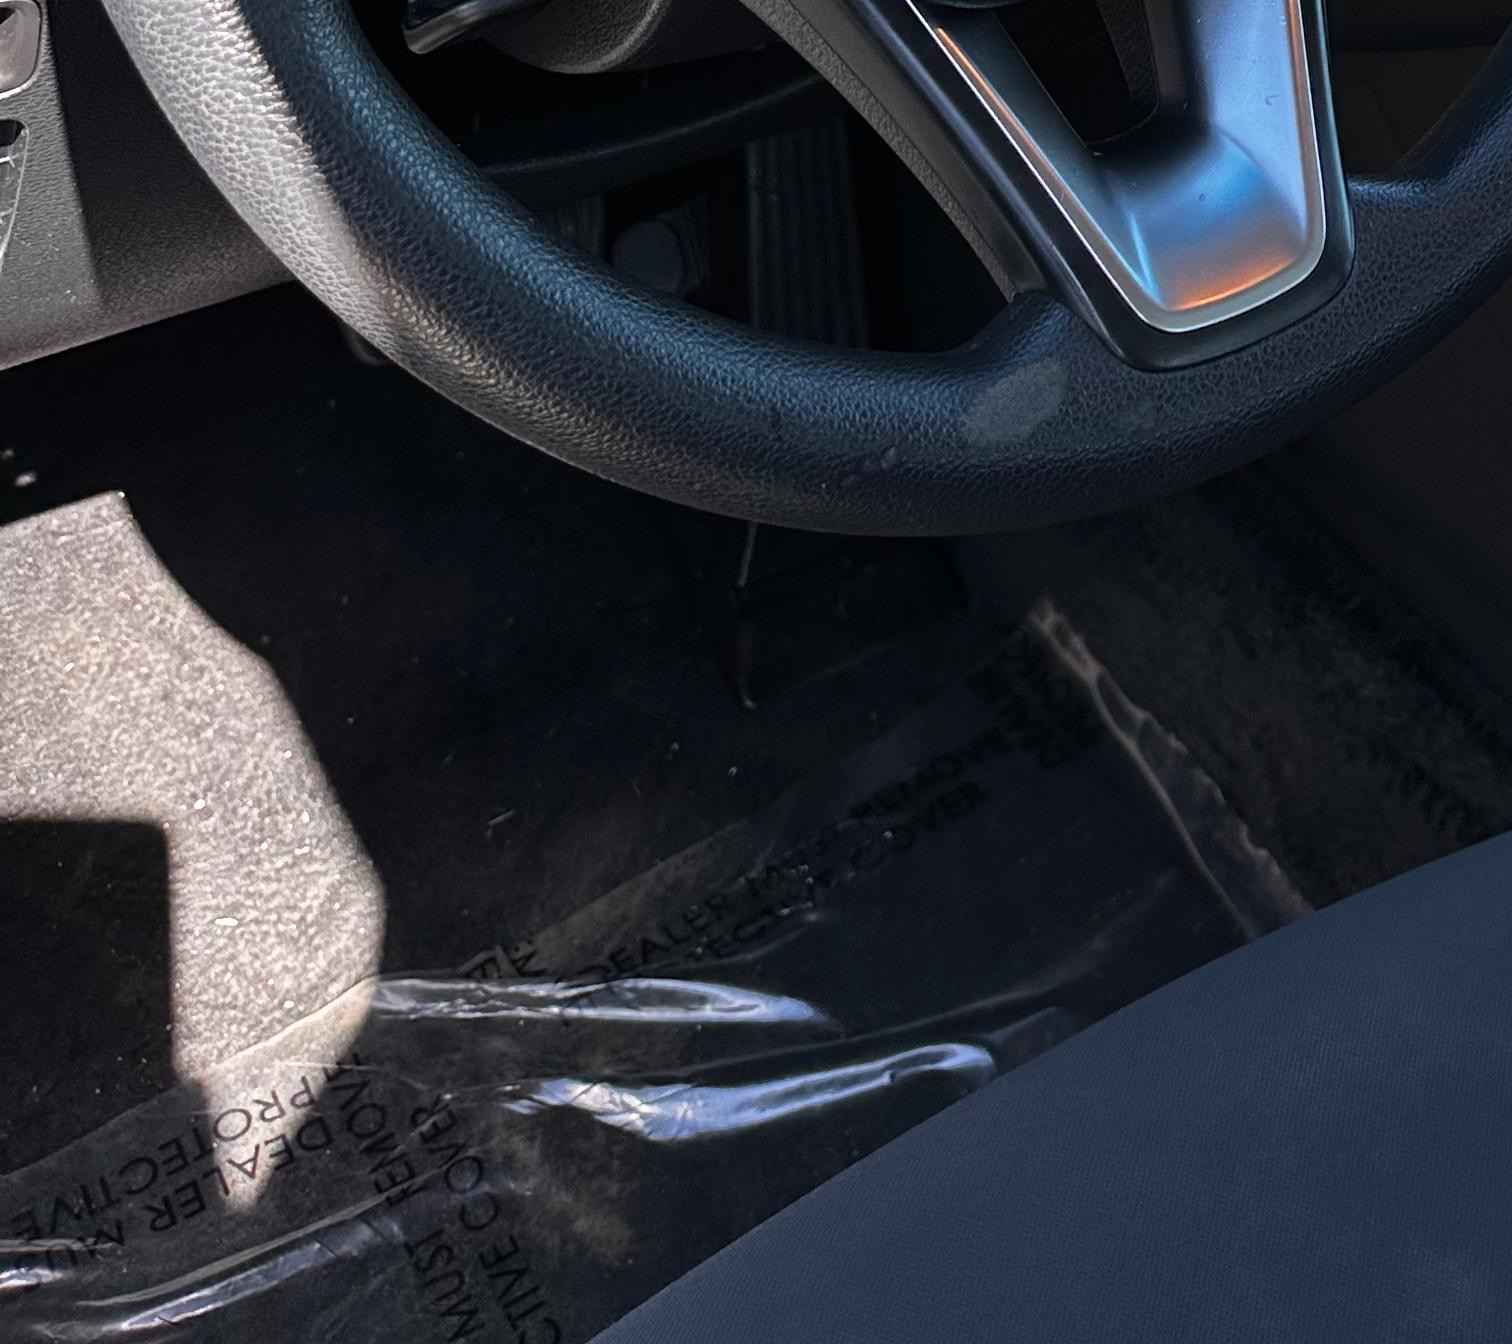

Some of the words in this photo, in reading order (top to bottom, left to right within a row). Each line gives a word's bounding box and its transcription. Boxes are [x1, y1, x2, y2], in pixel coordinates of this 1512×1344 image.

[10, 1074, 317, 1240] PROTECTIVE
[147, 1115, 334, 1232] DEALER
[410, 1091, 500, 1232] COVER
[404, 1228, 487, 1344] MUST
